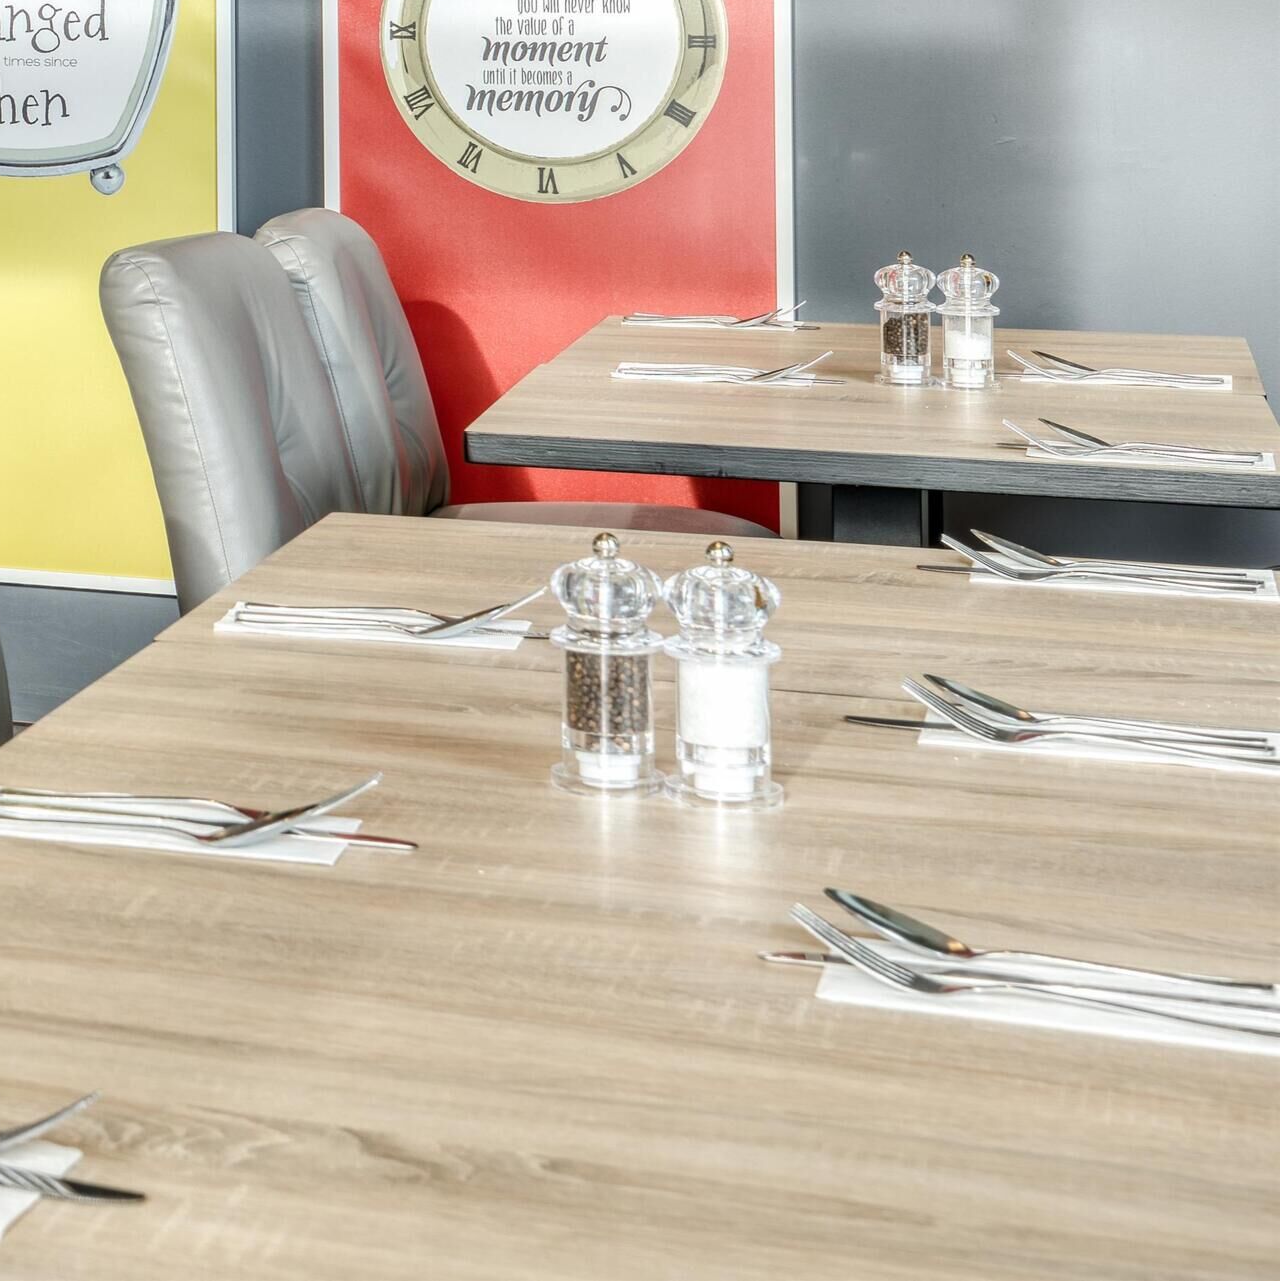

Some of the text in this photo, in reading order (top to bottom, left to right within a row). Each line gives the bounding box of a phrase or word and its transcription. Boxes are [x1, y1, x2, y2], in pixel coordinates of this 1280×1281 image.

[495, 16, 574, 36] the value of a
[687, 34, 717, 48] III
[481, 36, 608, 67] moment
[4, 55, 41, 67] times
[43, 56, 78, 67] since
[483, 68, 573, 85] until it becomes a
[465, 80, 632, 122] memory
